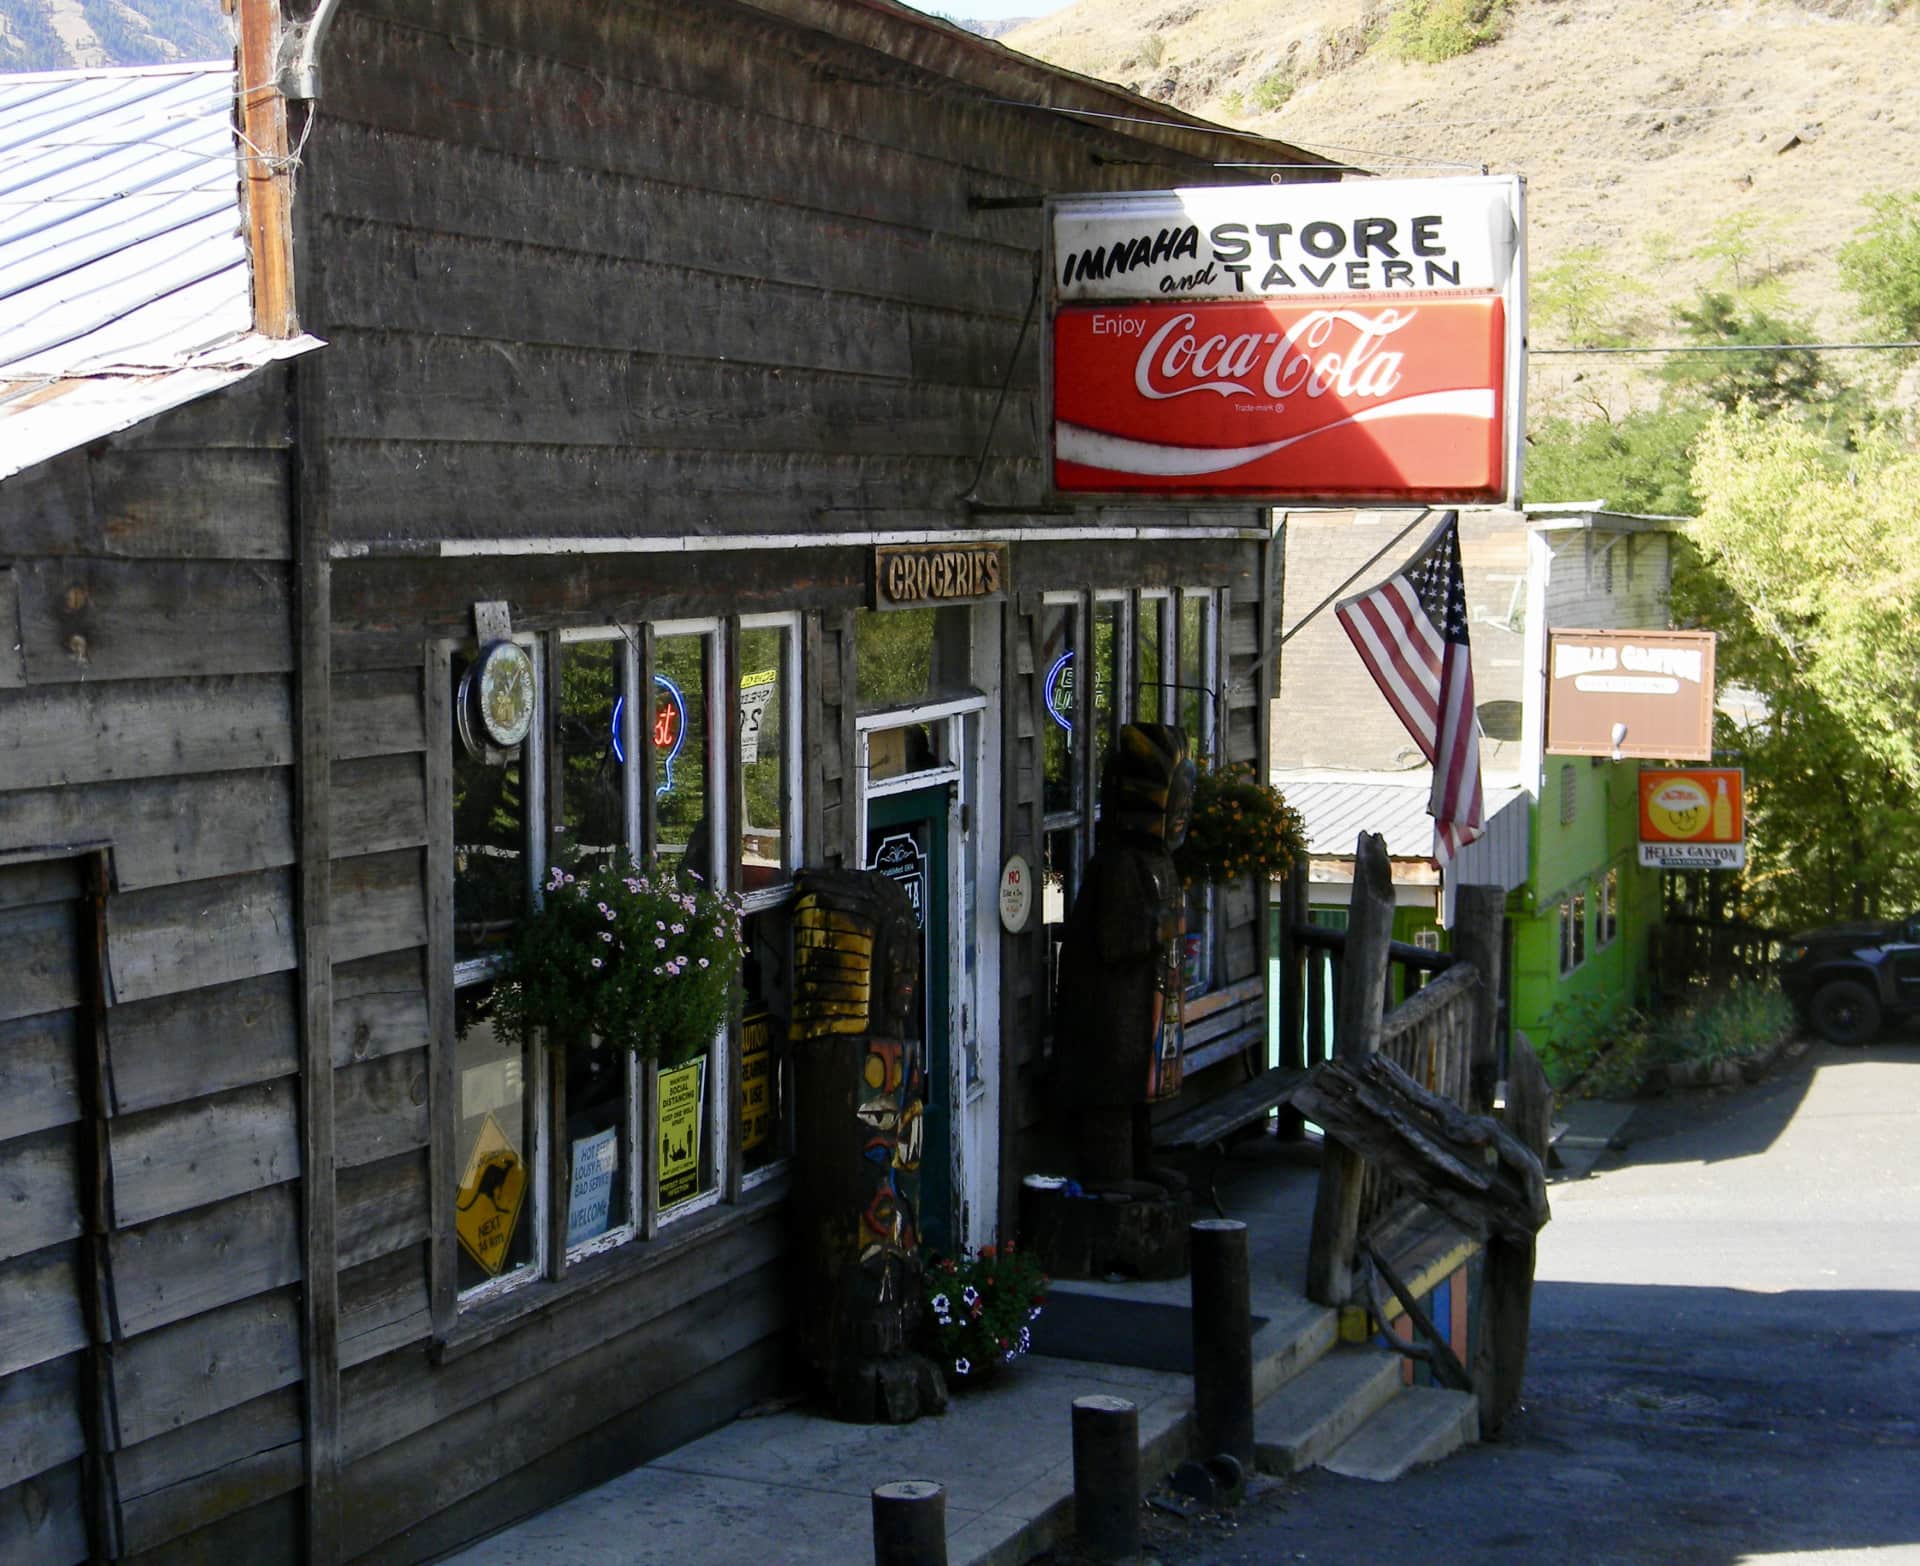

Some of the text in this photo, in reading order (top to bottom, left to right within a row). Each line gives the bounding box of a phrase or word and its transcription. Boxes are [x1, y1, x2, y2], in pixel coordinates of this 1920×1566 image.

[1210, 216, 1447, 262] STORE
[1062, 225, 1199, 287] IMNAHA
[1159, 260, 1460, 294] and TAVERN
[1091, 314, 1147, 338] Enjoy
[889, 551, 1001, 600] GROCERIES
[1645, 846, 1737, 862] HELLS CANYON
[1008, 870, 1020, 885] NO
[663, 1090, 694, 1108] DISTANCING
[670, 1081, 688, 1097] SOCIAL
[478, 1216, 500, 1240] NEXT
